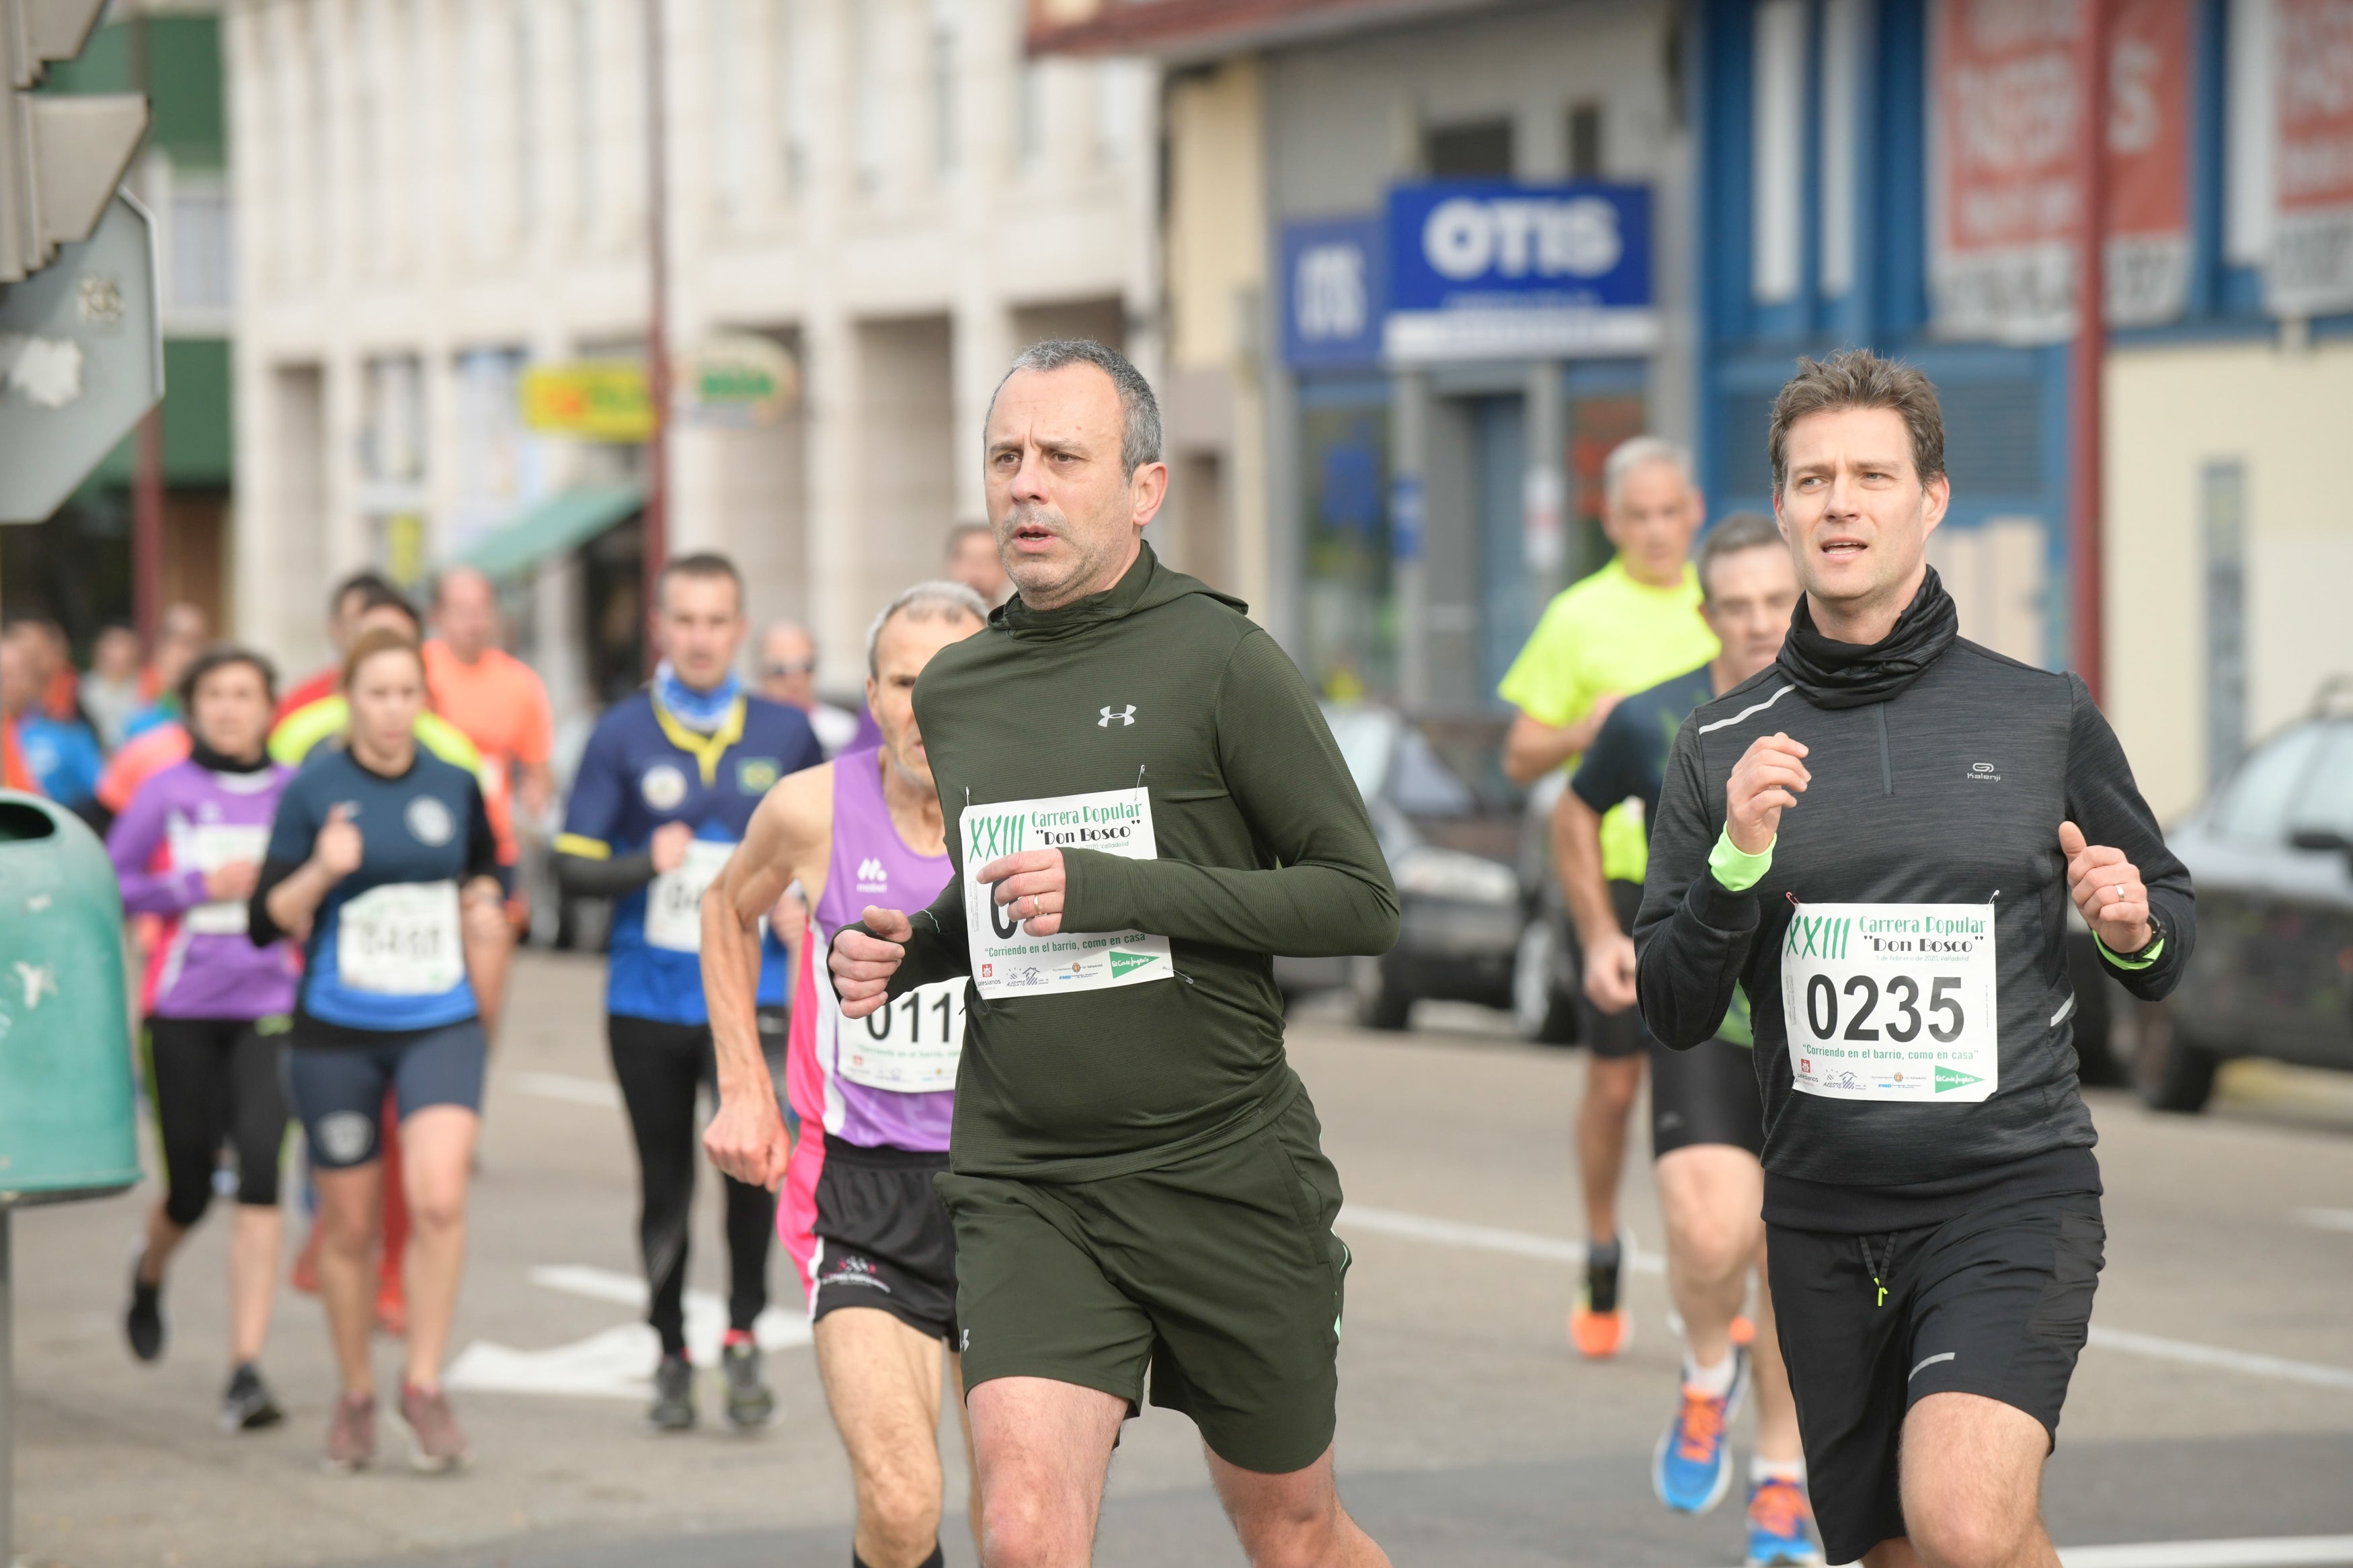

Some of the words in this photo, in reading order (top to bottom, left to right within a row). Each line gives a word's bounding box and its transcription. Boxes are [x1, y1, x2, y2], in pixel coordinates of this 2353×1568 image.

[1422, 196, 1622, 280] OTIS
[1967, 773, 2001, 782] Kalenji
[1032, 811, 1079, 827] Carrera
[1083, 802, 1142, 824] Popular
[969, 814, 1024, 864] XXIII
[1101, 841, 1129, 849] Valladolid
[1786, 915, 1850, 960] XXIII
[1860, 916, 1919, 933] Carrera
[1926, 917, 1987, 936] Popular
[1042, 943, 1049, 952] el
[1052, 941, 1080, 951] barrio,
[1082, 940, 1107, 949] como
[1110, 938, 1121, 946] en
[866, 992, 951, 1042] 011
[1807, 974, 1964, 1042] 0235
[1862, 1049, 1870, 1059] el
[1874, 1049, 1905, 1060] barrio,
